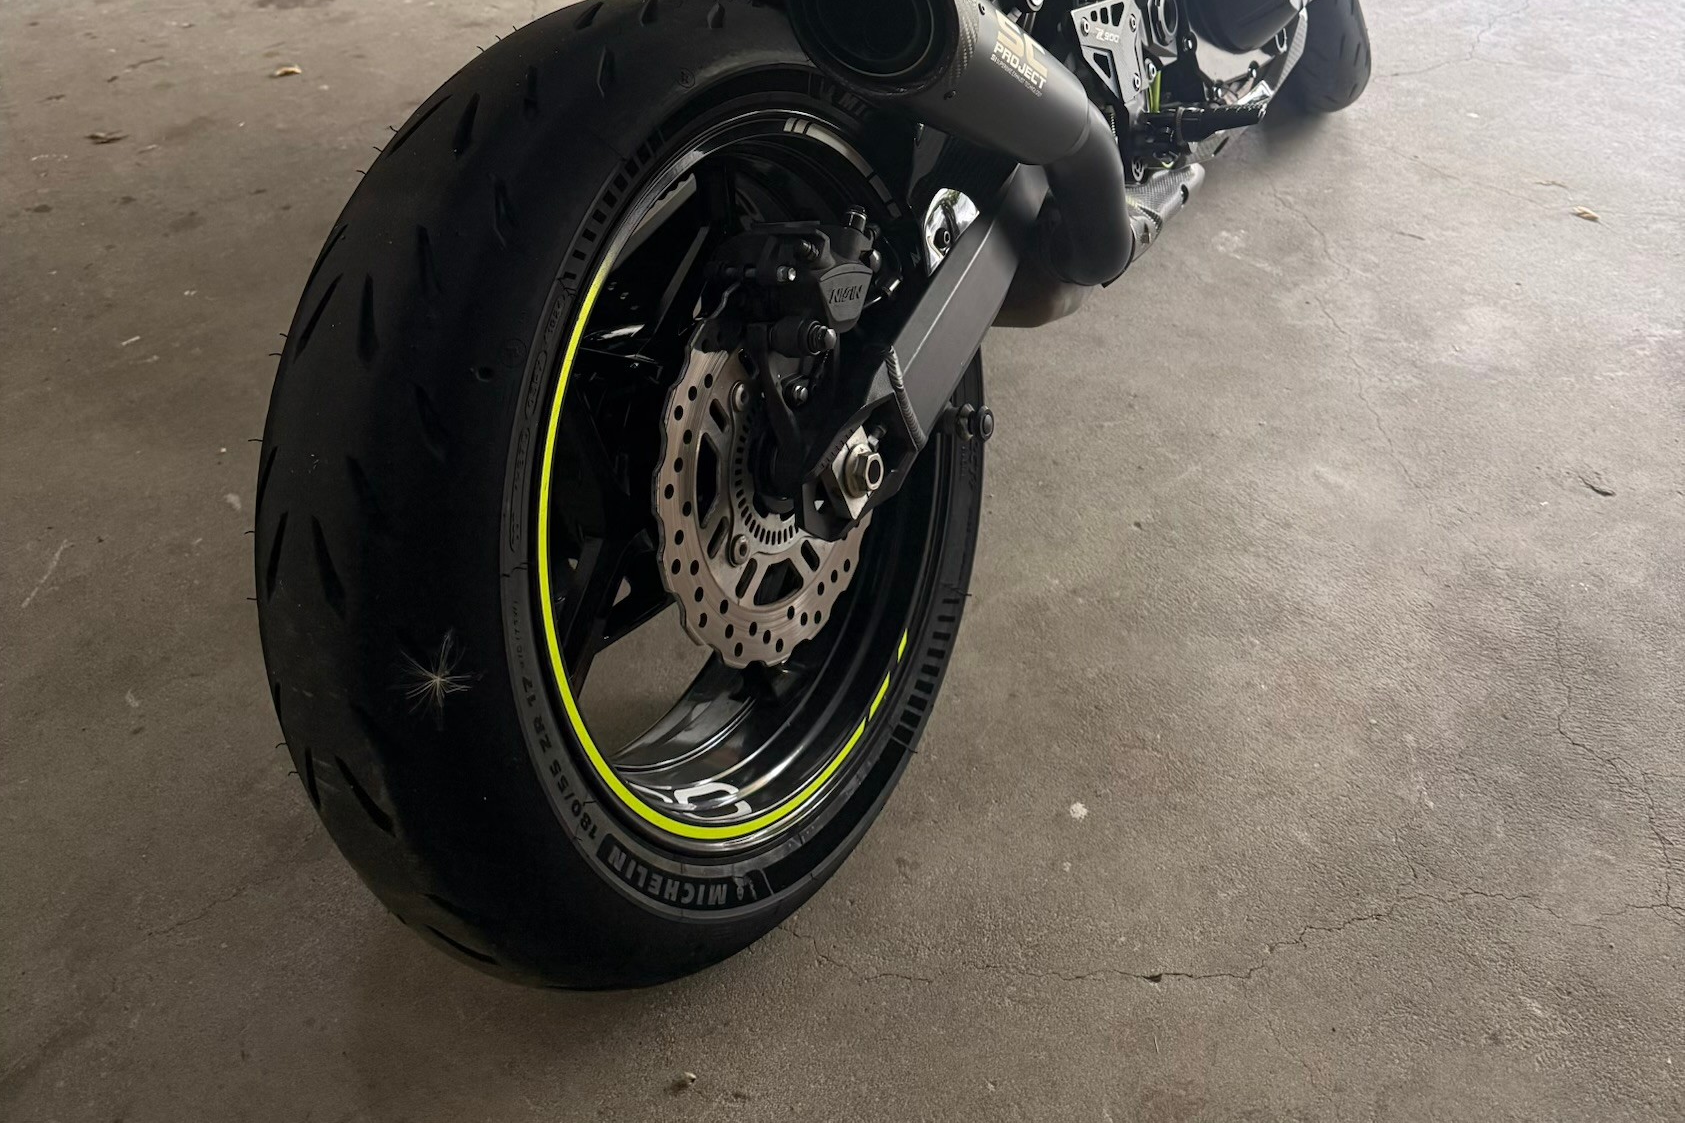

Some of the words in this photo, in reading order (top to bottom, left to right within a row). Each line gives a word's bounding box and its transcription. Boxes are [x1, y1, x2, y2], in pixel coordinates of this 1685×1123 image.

[1095, 27, 1120, 44] Z900
[993, 41, 1047, 89] PROJECT
[607, 845, 728, 906] MICHELIN
